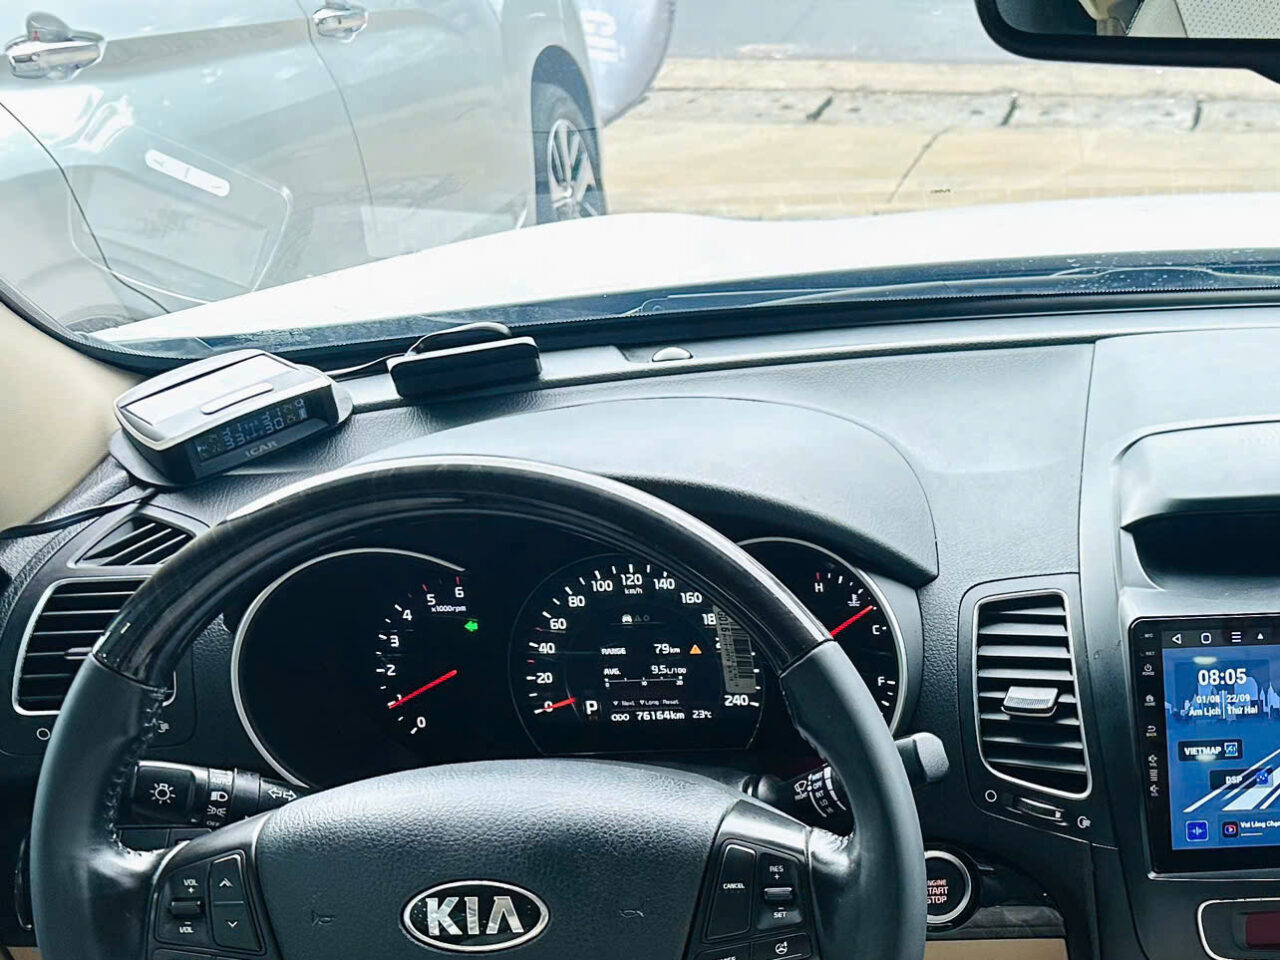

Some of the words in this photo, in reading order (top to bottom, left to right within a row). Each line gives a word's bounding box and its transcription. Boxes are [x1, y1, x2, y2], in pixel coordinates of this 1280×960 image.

[591, 580, 613, 592] 100
[620, 574, 643, 586] 120
[653, 578, 675, 590] 140
[455, 587, 464, 598] 6
[814, 583, 824, 593] H
[426, 594, 436, 606] 5
[568, 596, 585, 608] 80
[680, 592, 702, 604] 160
[402, 609, 412, 621] 4
[550, 618, 567, 630] 60
[872, 625, 880, 635] C
[389, 635, 400, 648] 3
[538, 643, 555, 654] 40
[386, 664, 396, 676] 2
[536, 673, 553, 684] 20
[877, 676, 885, 686] F
[1198, 668, 1247, 686] 08:05
[724, 695, 749, 707] 240
[585, 701, 598, 714] P
[417, 716, 426, 728] 0
[611, 712, 629, 721] ODO
[1184, 746, 1222, 756] VIETMAP
[1225, 775, 1243, 785] DSP
[769, 865, 784, 873] RES
[425, 896, 524, 936] KIA
[773, 911, 788, 919] SET
